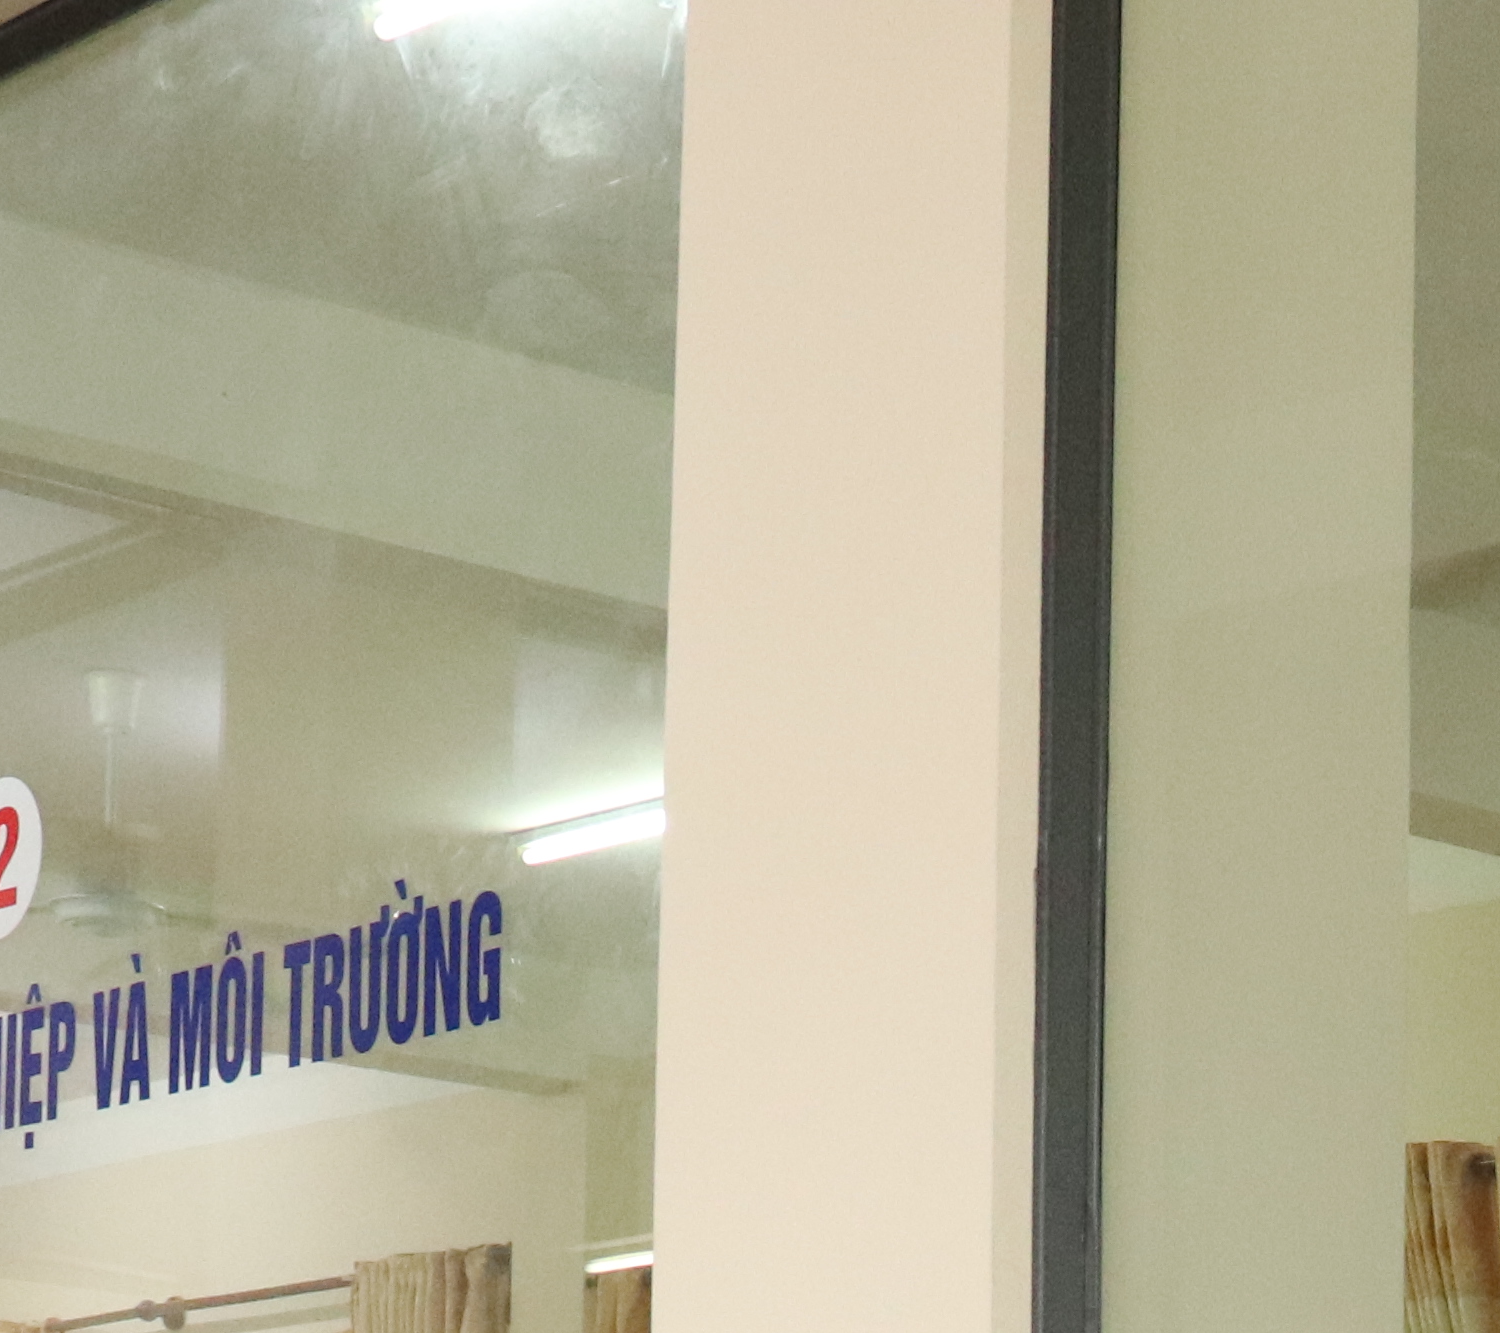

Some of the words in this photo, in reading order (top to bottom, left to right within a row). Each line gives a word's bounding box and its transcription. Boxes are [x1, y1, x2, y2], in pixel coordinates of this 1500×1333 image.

[94, 953, 150, 1110] VÀ
[169, 931, 264, 1094] MÔI
[285, 879, 503, 1068] TRƯỜNG
